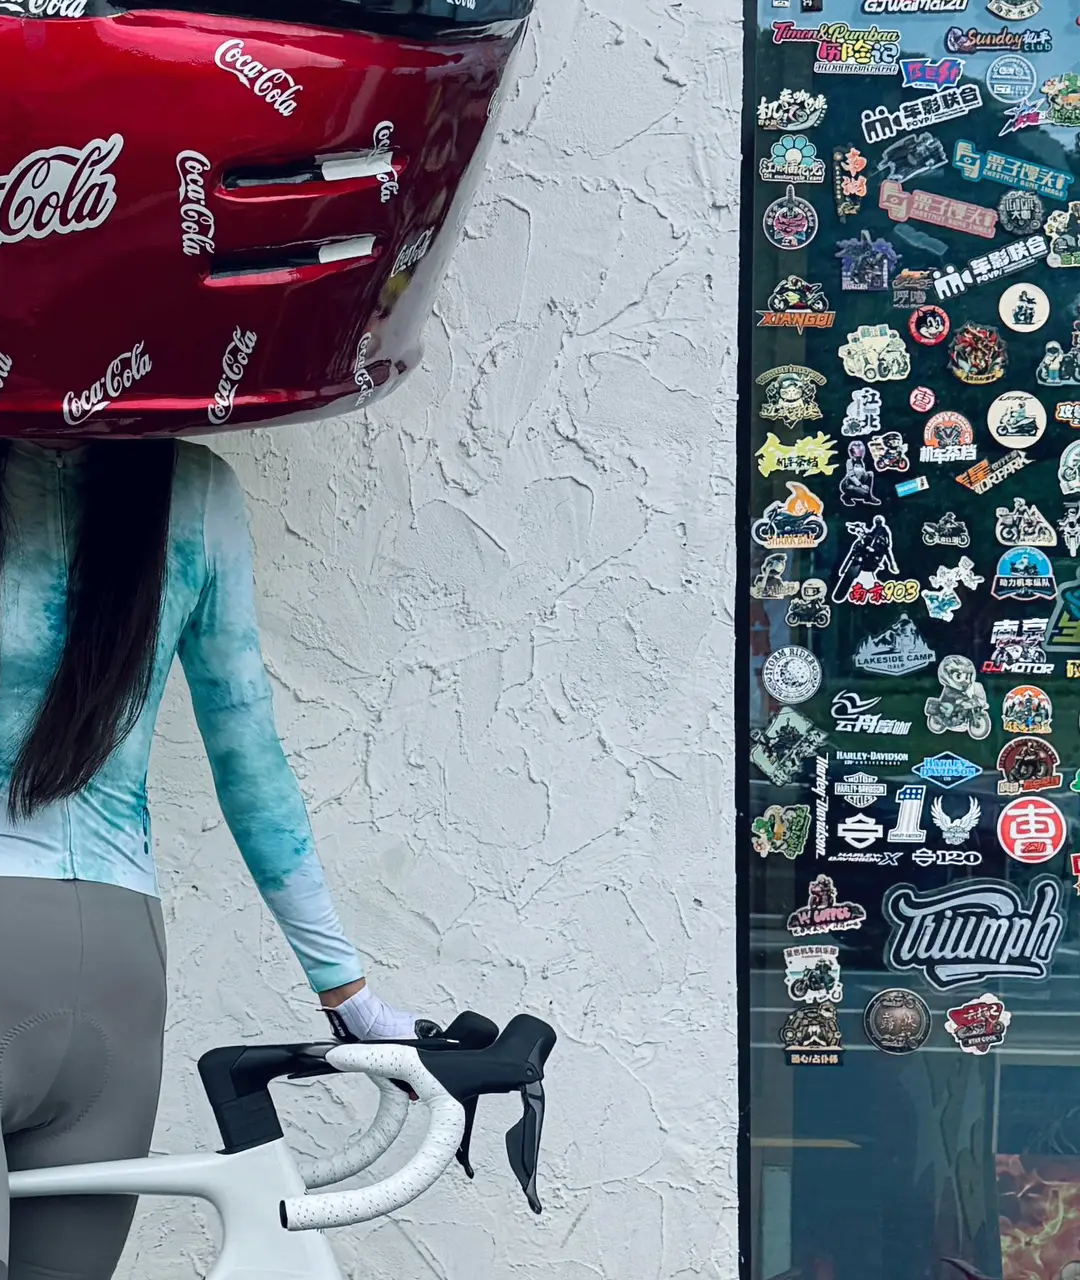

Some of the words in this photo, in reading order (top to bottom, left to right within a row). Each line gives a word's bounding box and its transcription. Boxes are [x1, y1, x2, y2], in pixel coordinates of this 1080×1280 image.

[214, 39, 304, 117] Coca-Cola
[176, 149, 214, 256] Coca-Cola
[62, 340, 152, 425] Coca-Cola
[208, 325, 257, 424] Coca-Cola
[857, 655, 904, 665] LAKESIDE
[906, 653, 933, 662] CAMP
[899, 885, 1058, 963] Triumph
